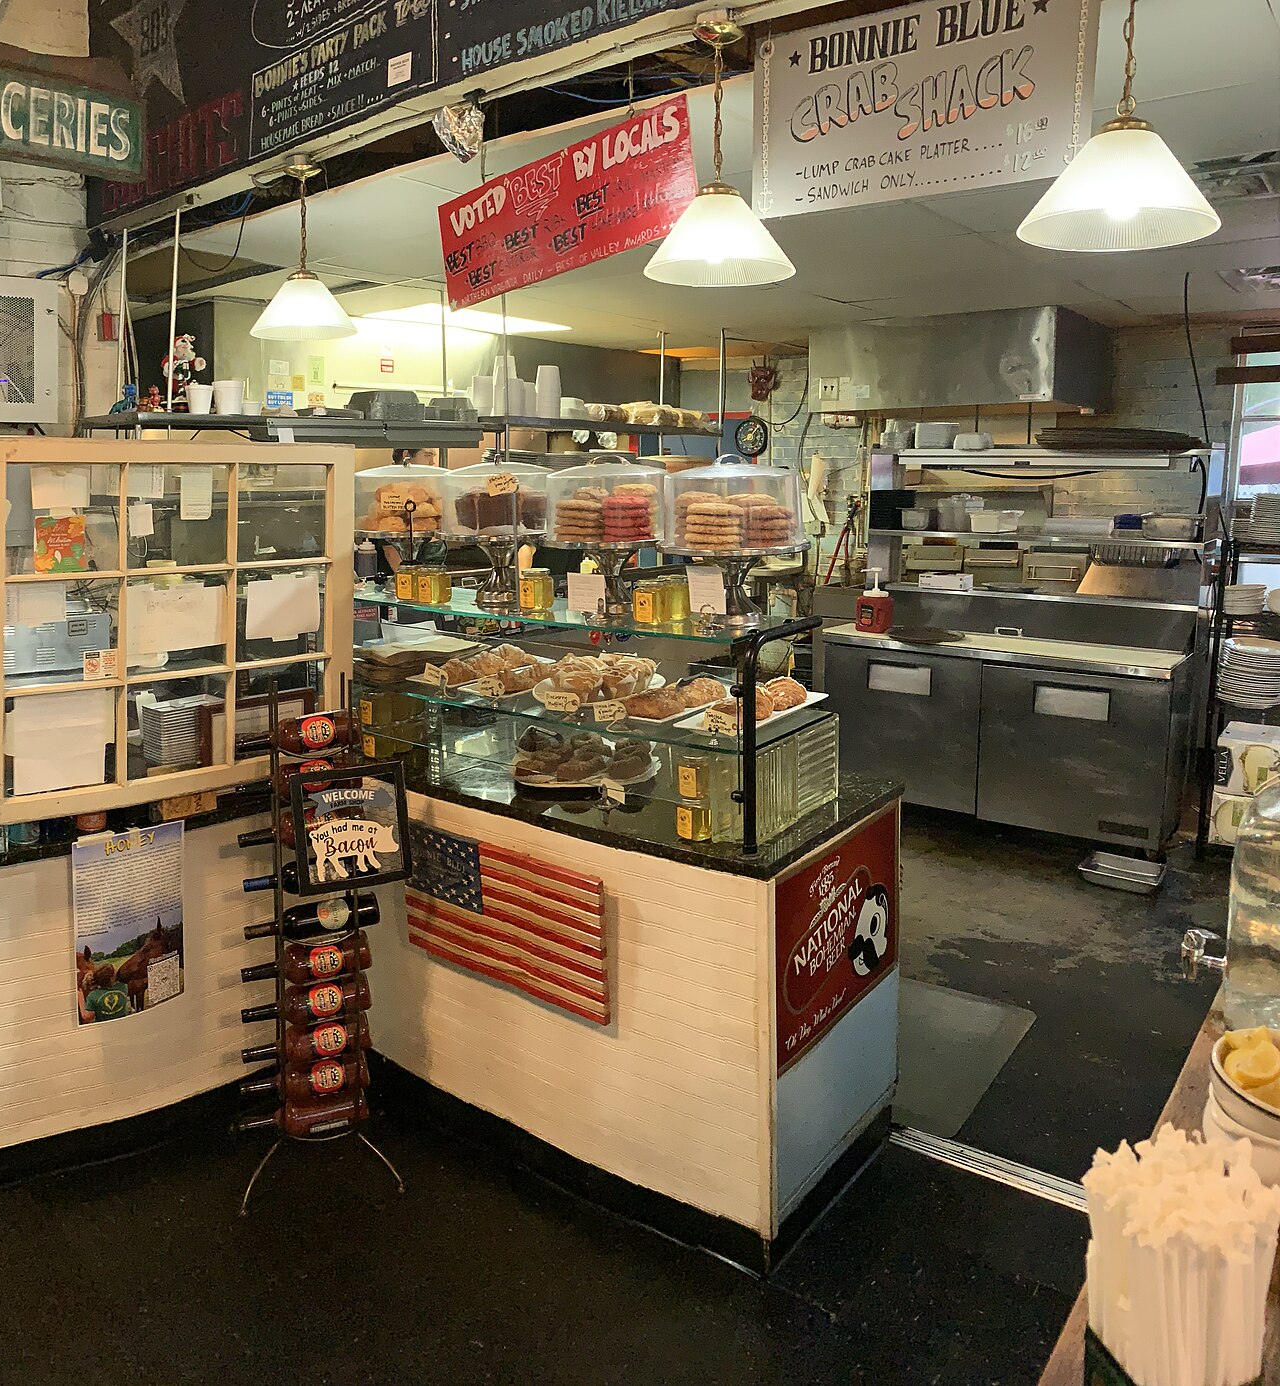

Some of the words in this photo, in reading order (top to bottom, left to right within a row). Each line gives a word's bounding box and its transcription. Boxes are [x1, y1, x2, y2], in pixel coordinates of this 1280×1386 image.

[254, 52, 309, 98] BONNIE'S
[310, 31, 350, 69] PARTY
[353, 10, 387, 49] PACK
[462, 32, 511, 72] HOUSE
[516, 6, 594, 55] SMOKED
[808, 14, 921, 74] BONNIE
[936, 0, 1026, 48] BLUE
[300, 67, 325, 89] FEEDS
[329, 59, 340, 74] 12
[790, 61, 899, 143] CRAB
[893, 44, 1036, 141] SHACK
[301, 112, 324, 133] BREAD
[450, 186, 506, 237] VOTED
[573, 142, 597, 181] BY
[602, 105, 681, 171] LOCALS
[807, 179, 869, 203] SANDWICH
[844, 154, 876, 173] CRAB
[879, 150, 911, 166] CAKE
[446, 240, 474, 272] BEST
[504, 222, 539, 252] BEST
[575, 183, 610, 217] BEST
[468, 260, 497, 286] BEST
[552, 222, 586, 252] BEST
[523, 269, 544, 286] DAILY
[555, 257, 574, 273] BEST
[580, 252, 589, 262] OF
[590, 241, 619, 261] VALLEY
[623, 225, 660, 249] AWARDS
[321, 790, 375, 804] WELCOME
[313, 830, 329, 844] You
[332, 822, 348, 834] had
[351, 824, 364, 832] me
[368, 825, 378, 835] at
[325, 836, 378, 857] Bacon
[793, 878, 863, 975] NATIONAL
[810, 907, 856, 976] BOHEMIAN
[826, 939, 846, 972] BEER
